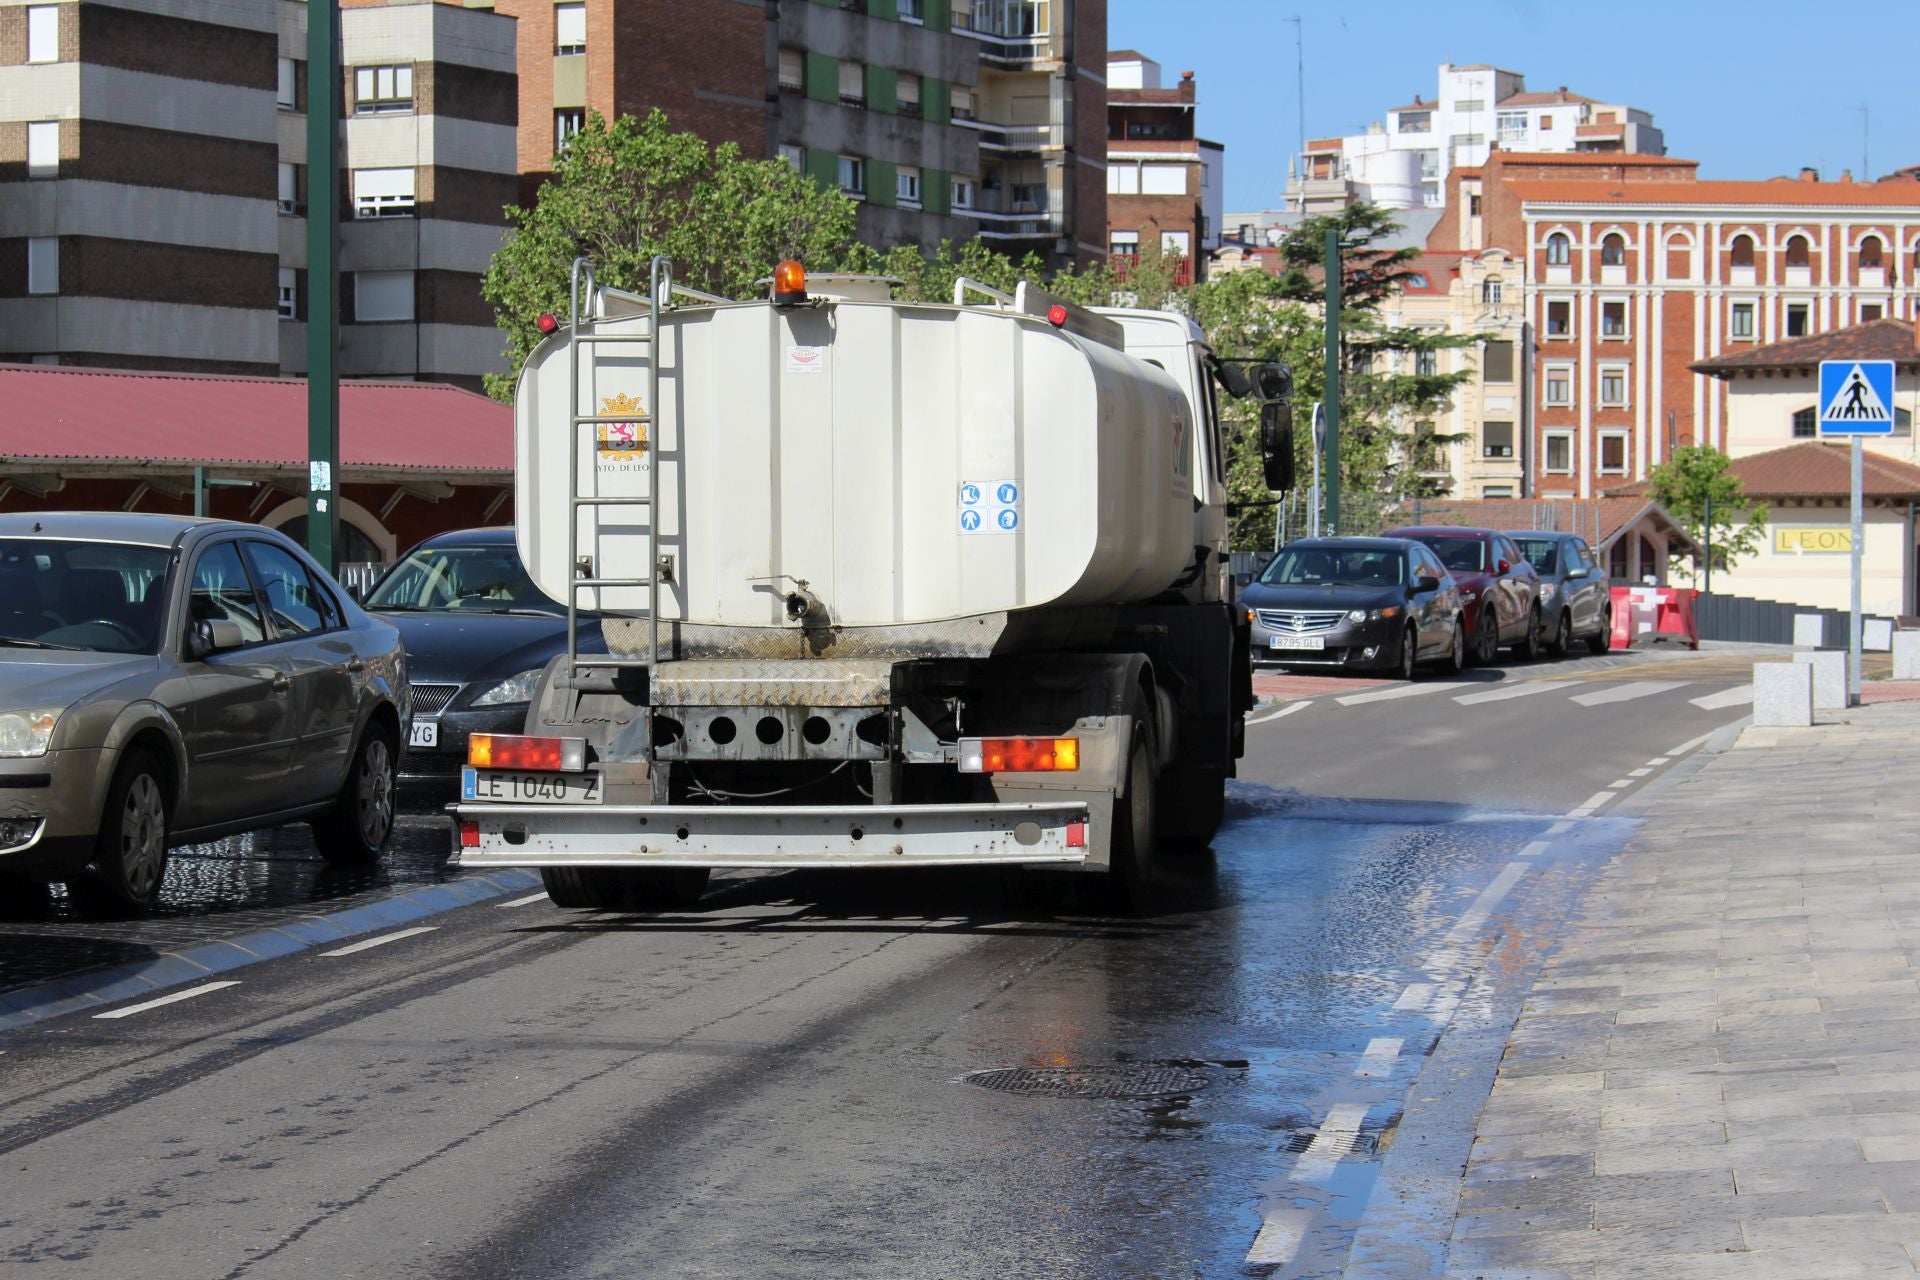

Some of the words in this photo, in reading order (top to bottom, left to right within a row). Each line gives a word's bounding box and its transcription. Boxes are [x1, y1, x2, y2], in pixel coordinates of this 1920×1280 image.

[620, 464, 631, 472] DE
[634, 464, 651, 472] LEO
[1782, 531, 1852, 549] LEON
[1277, 638, 1301, 648] 8795
[1304, 638, 1322, 648] GLL
[412, 726, 432, 743] YG
[476, 774, 503, 797] LE
[512, 775, 567, 800] 1040
[583, 777, 599, 800] Z
